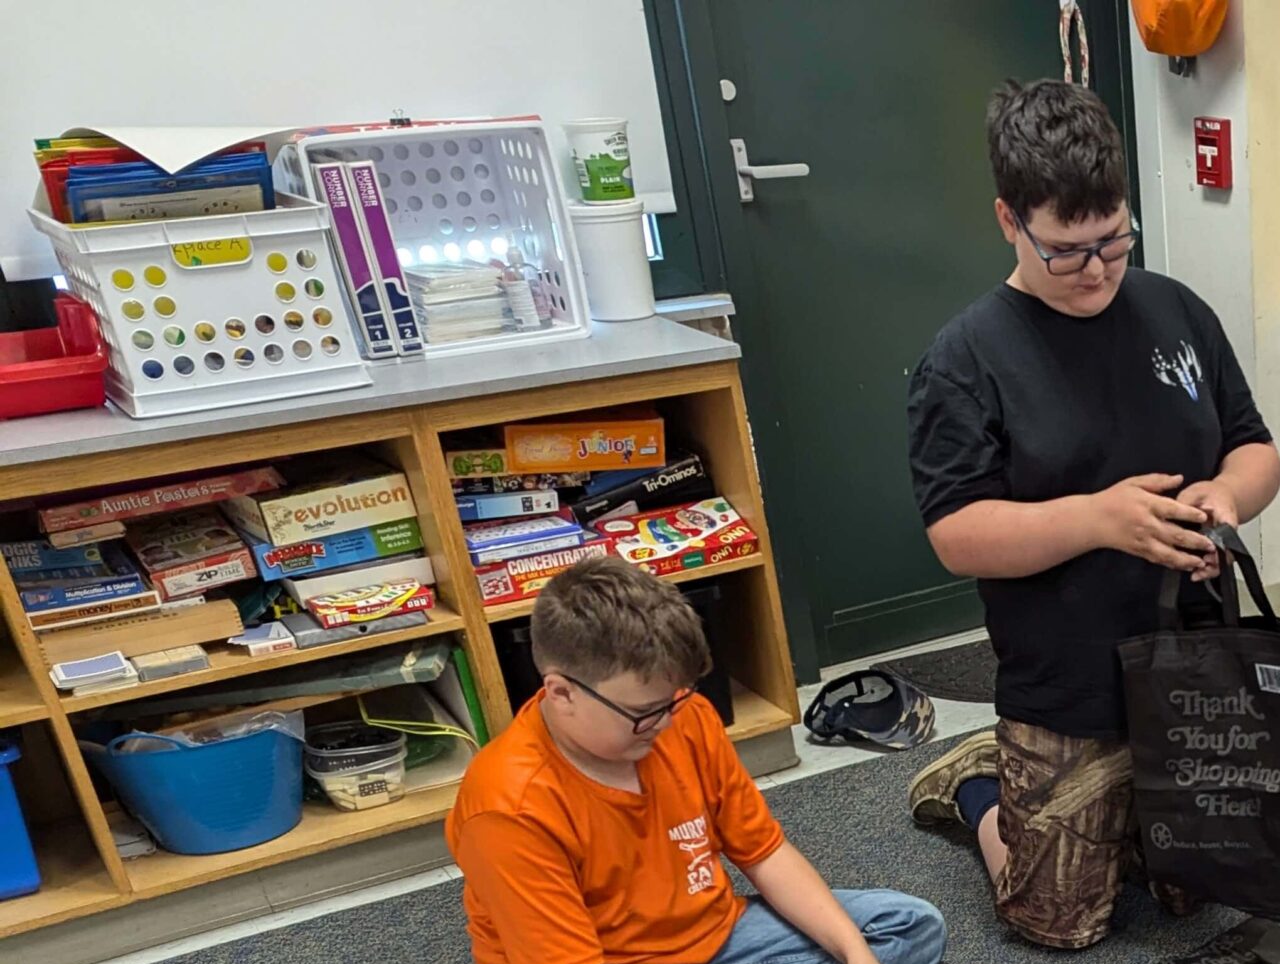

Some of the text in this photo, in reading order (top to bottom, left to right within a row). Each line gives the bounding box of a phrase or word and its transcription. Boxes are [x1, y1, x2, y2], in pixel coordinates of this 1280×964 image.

[323, 170, 340, 209] CORNER
[330, 169, 347, 208] NUMBER
[355, 169, 372, 208] CORNER
[361, 169, 378, 207] NUMBER
[230, 238, 243, 250] A
[374, 330, 383, 340] 1
[404, 328, 412, 338] 2
[578, 430, 636, 461] JUNIOR
[642, 465, 698, 493] Tri-Ominos
[101, 494, 151, 515] Auntie
[293, 486, 408, 524] evolution
[718, 525, 750, 545] UNO
[65, 584, 106, 598] Multiplication
[112, 581, 137, 592] Division
[195, 569, 219, 582] ZIP
[77, 602, 114, 617] money
[1169, 686, 1266, 722] Thank
[1167, 724, 1271, 756] You for
